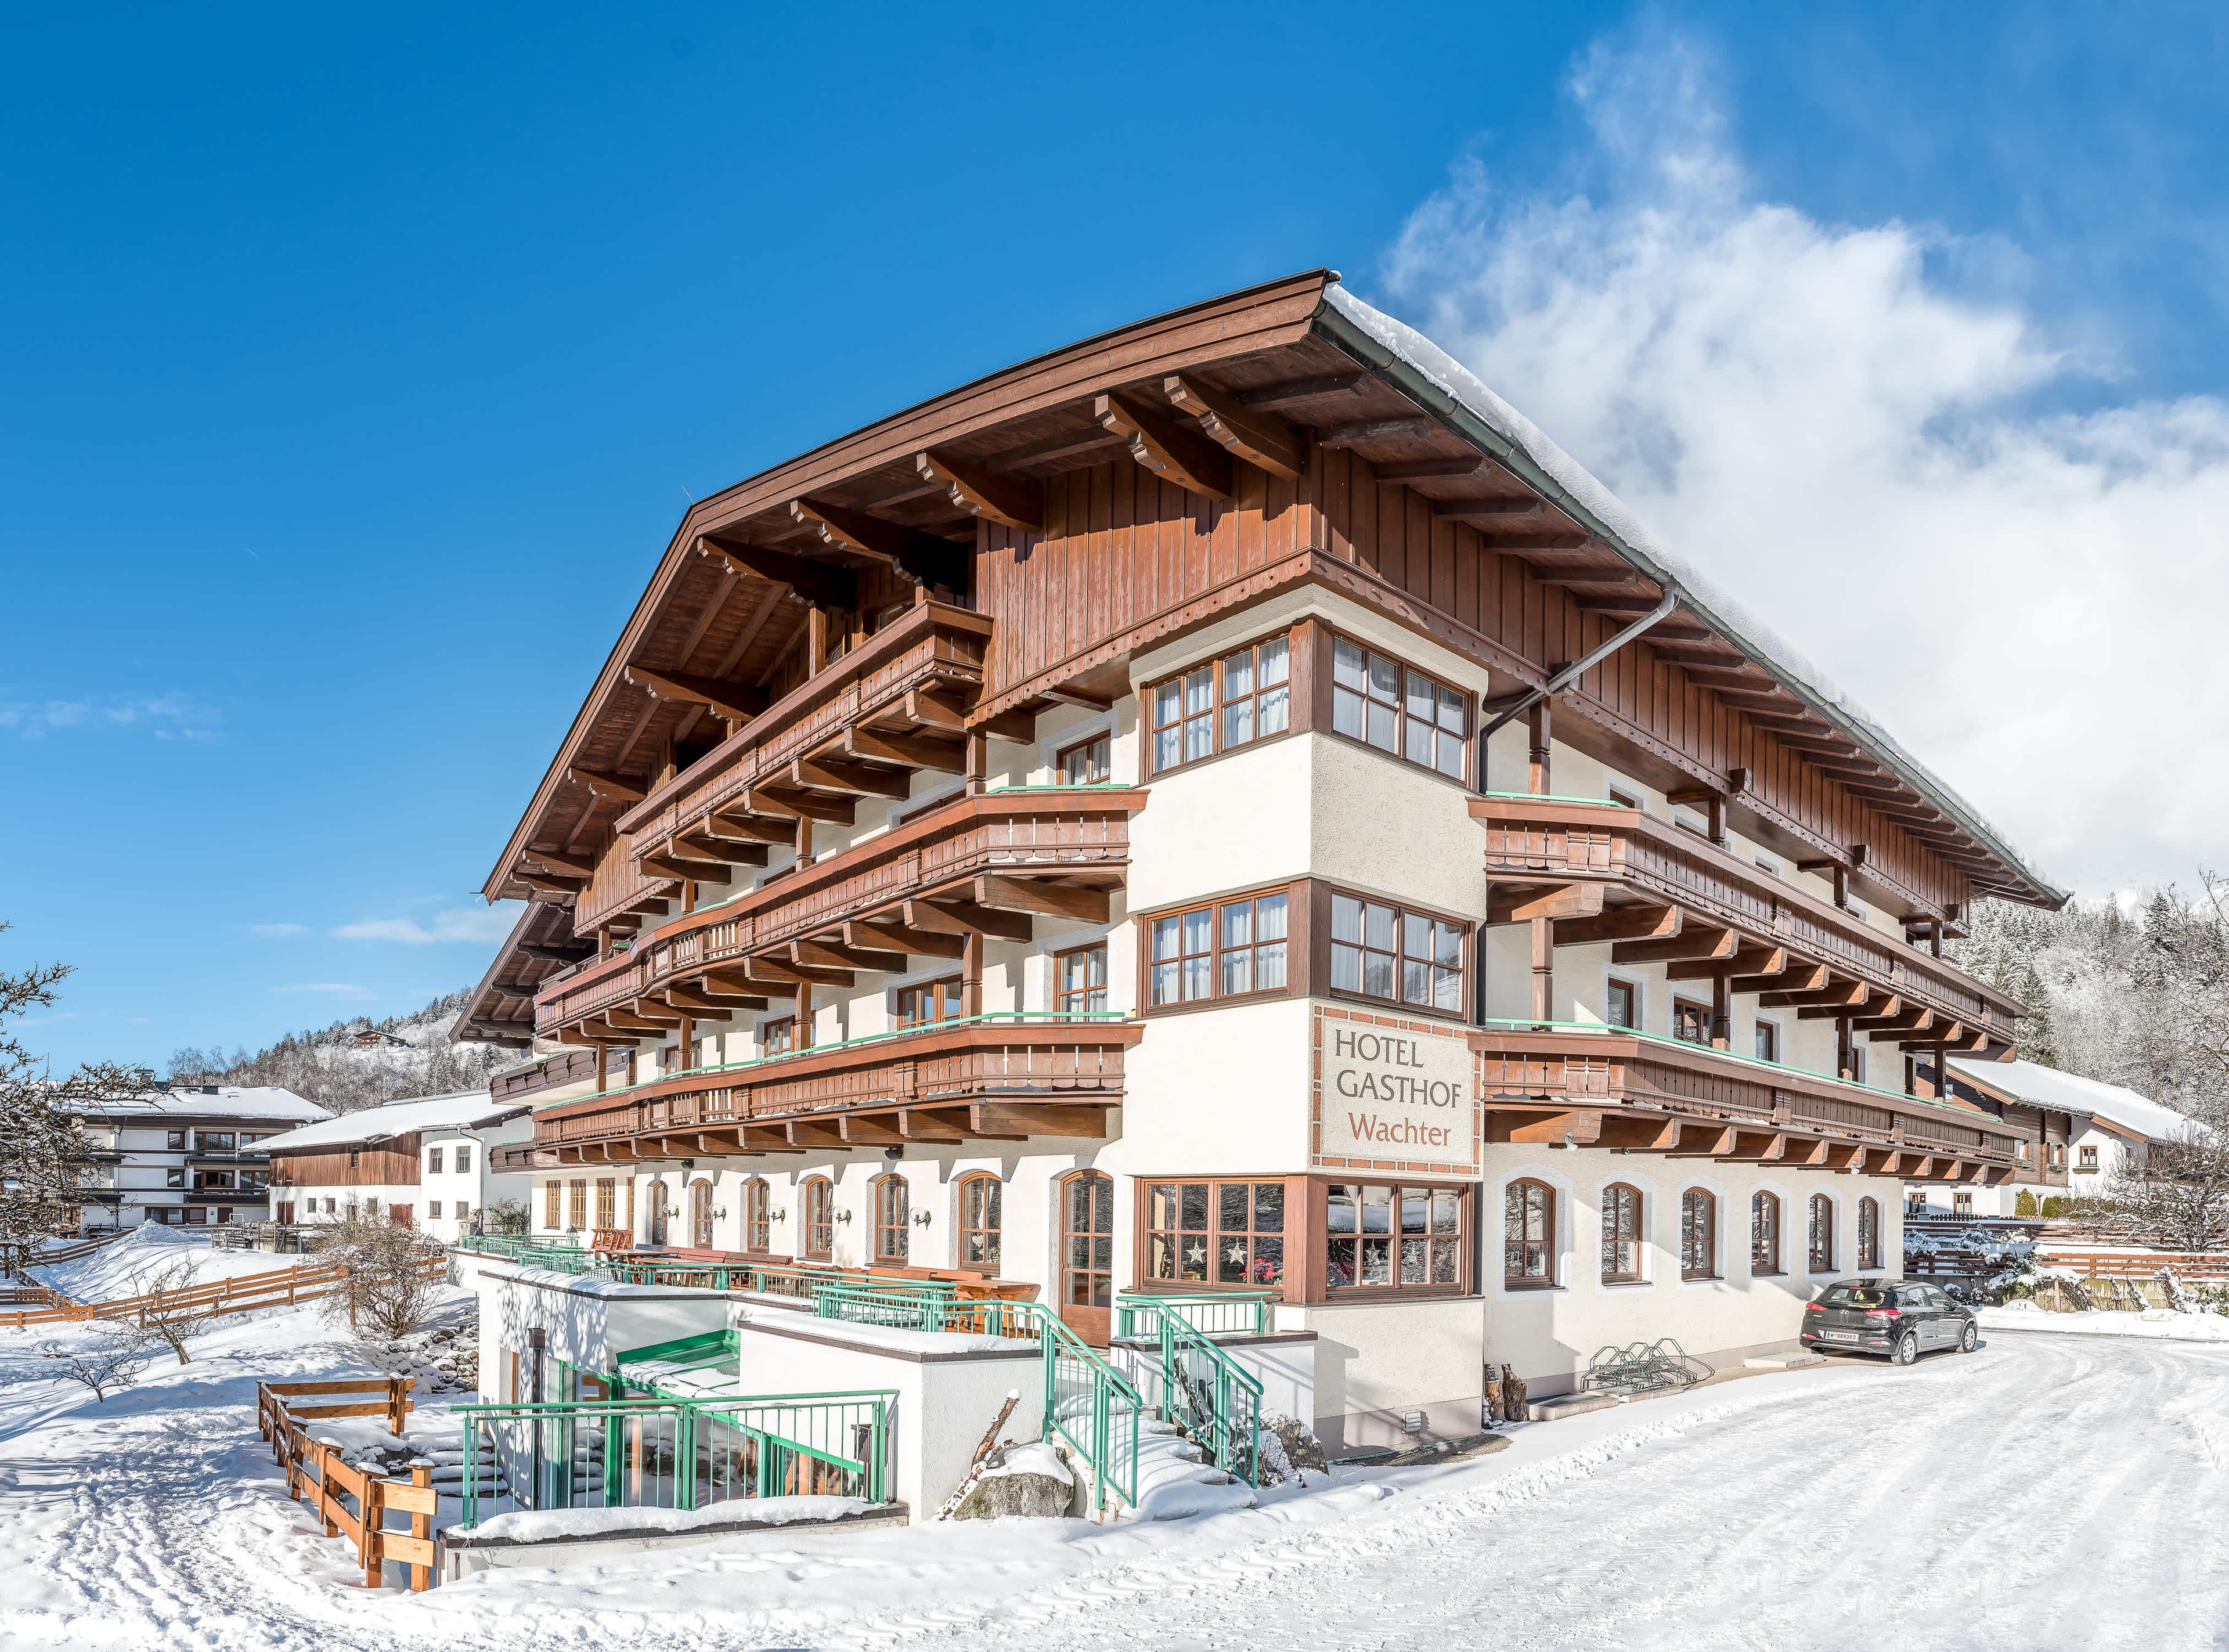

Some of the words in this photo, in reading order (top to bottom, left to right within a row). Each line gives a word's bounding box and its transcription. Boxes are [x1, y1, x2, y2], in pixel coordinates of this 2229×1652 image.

[1335, 1029, 1424, 1068] HOTEL
[1337, 1069, 1462, 1108] GASTHOF
[1348, 1112, 1451, 1146] Wachter
